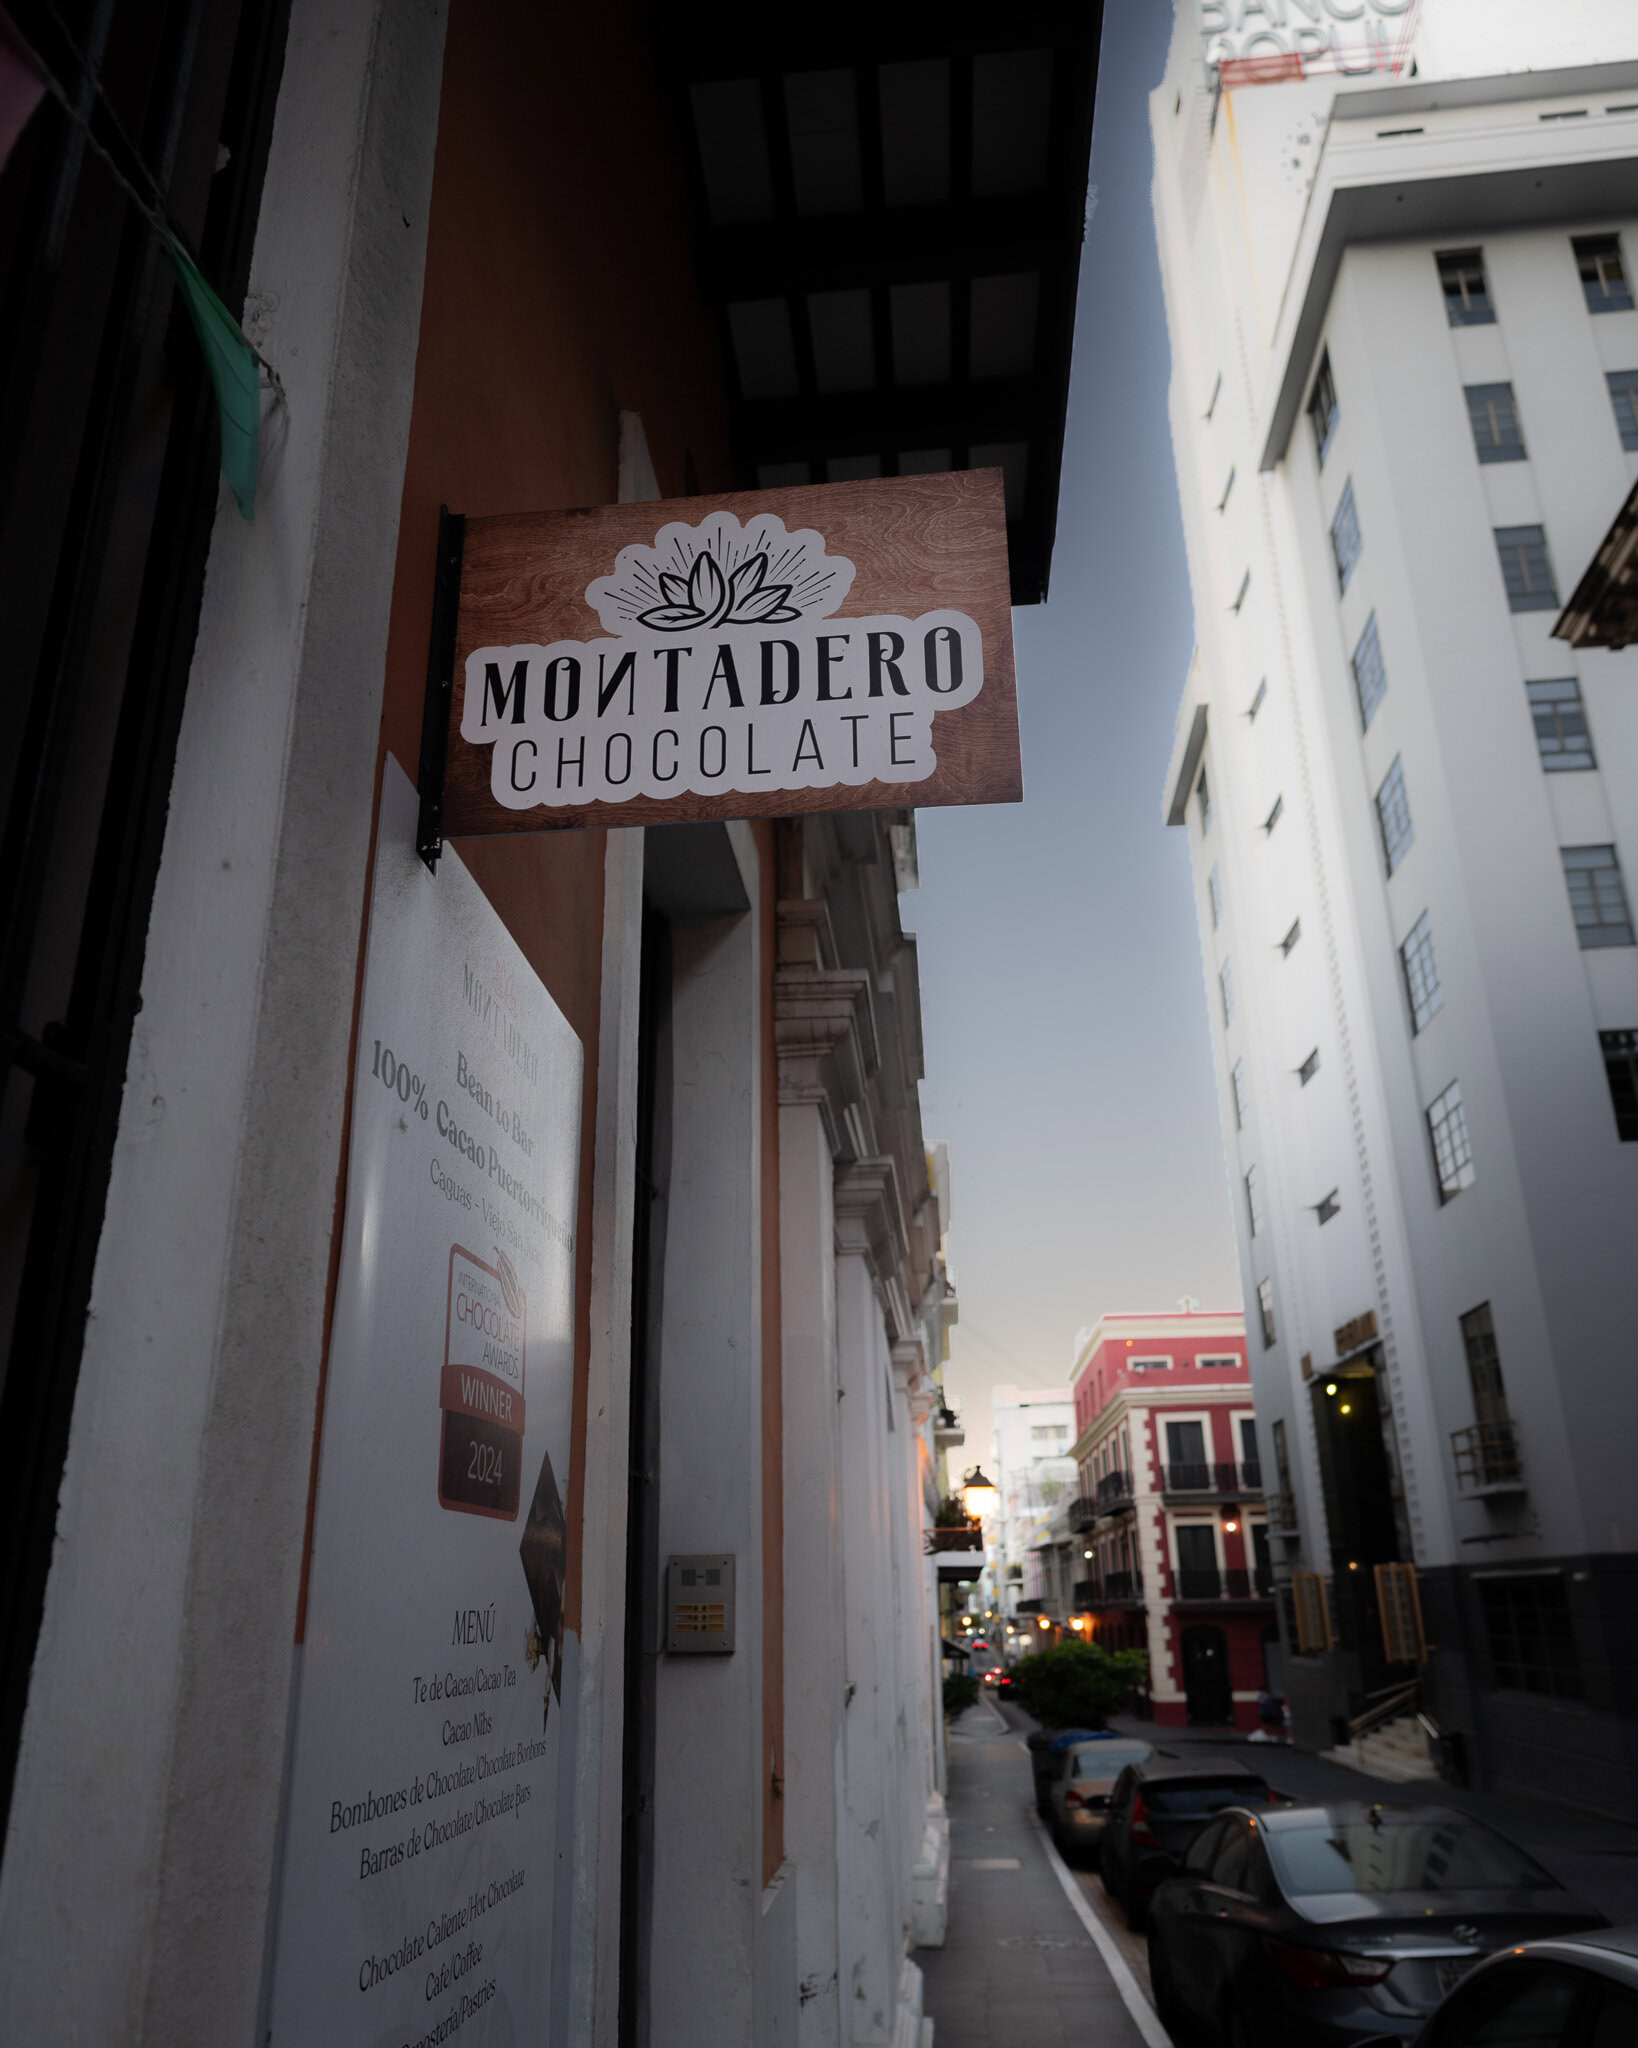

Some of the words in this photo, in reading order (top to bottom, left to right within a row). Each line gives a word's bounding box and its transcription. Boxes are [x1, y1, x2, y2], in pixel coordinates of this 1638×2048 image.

[480, 626, 964, 727] MONTADERO
[510, 711, 917, 792] CHOCOLATE
[372, 1040, 428, 1120] 100%
[436, 1100, 486, 1169] Cacao
[457, 1050, 493, 1118] Bean
[496, 1099, 509, 1133] to
[512, 1111, 534, 1157] Bar
[430, 1158, 472, 1211] Caguas
[482, 1197, 505, 1238] Viejo
[456, 1293, 520, 1352] CHOCOLATE
[482, 1341, 519, 1380] AWARDS
[461, 1373, 512, 1422] WINNER
[467, 1440, 503, 1485] 2024
[452, 1602, 496, 1645] MENÚ
[412, 1677, 427, 1704] Te
[429, 1674, 443, 1702] de
[444, 1667, 501, 1698] Cacao/Cacao
[503, 1664, 517, 1687] Tea
[442, 1719, 472, 1746] Cacao
[473, 1711, 493, 1738] Nibs
[330, 1788, 407, 1833] Bombones
[409, 1776, 424, 1806] de
[426, 1747, 516, 1800] Chocolate/Chocolate
[517, 1738, 547, 1766] Bonbons
[360, 1842, 404, 1879] Barras
[407, 1828, 421, 1859] de
[423, 1789, 514, 1851] Chocolate/Chocolate
[515, 1783, 531, 1809] Bars
[359, 1936, 424, 1992] Chocolate
[426, 1893, 487, 1950] Caliente/Hot
[487, 1868, 525, 1908] Chocolate
[425, 1941, 482, 2001] Cafe/Coffee
